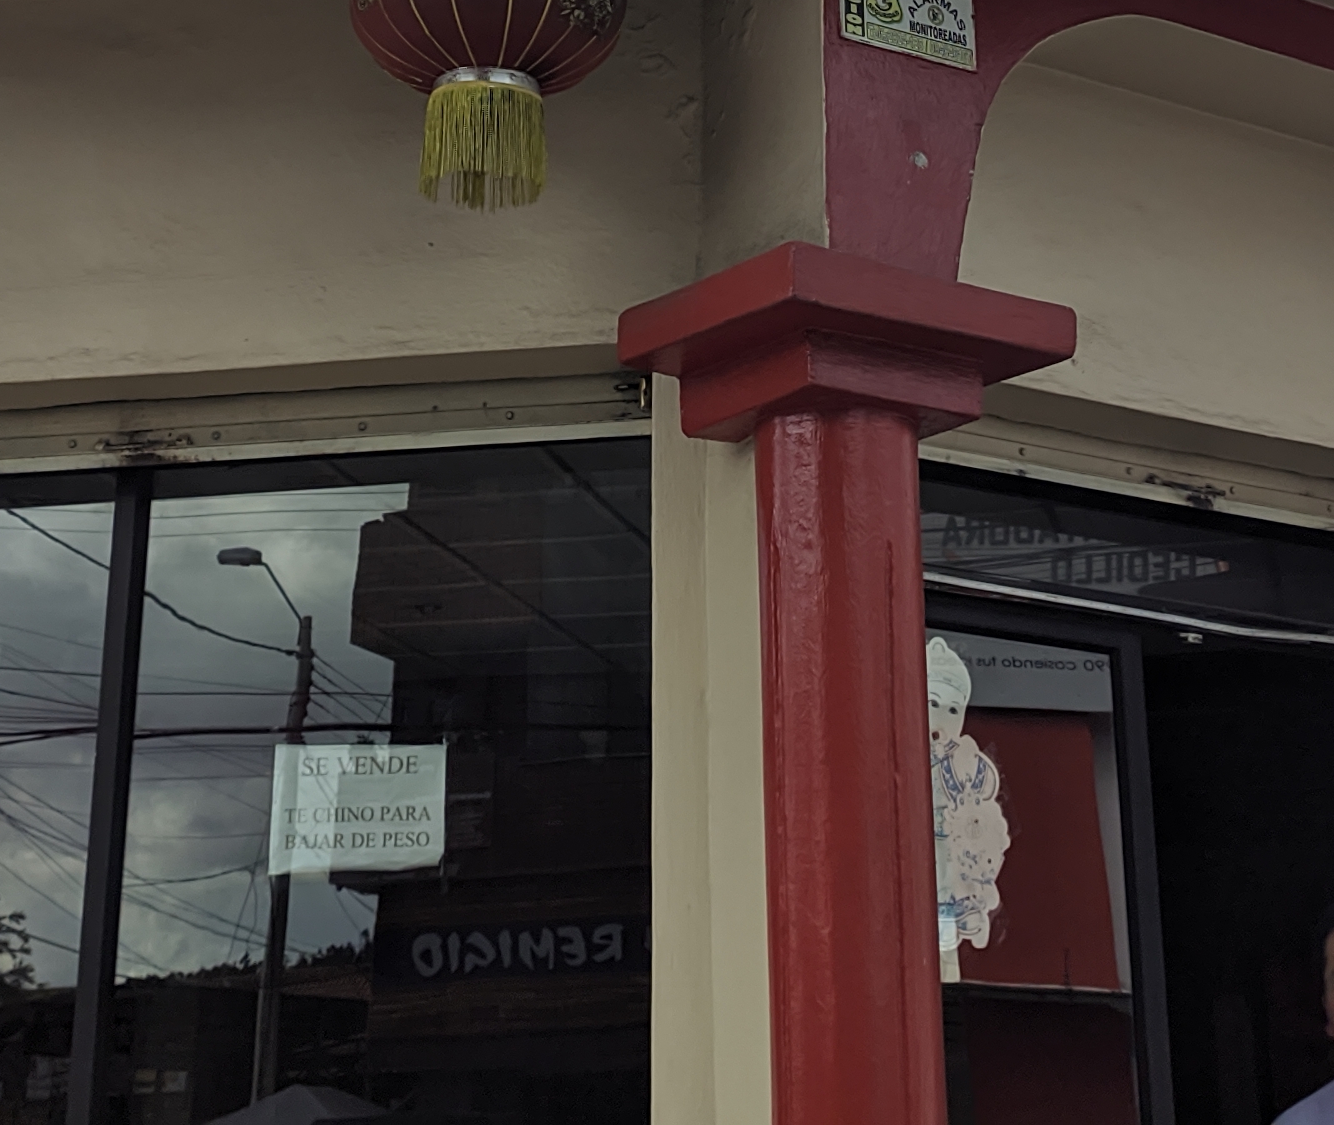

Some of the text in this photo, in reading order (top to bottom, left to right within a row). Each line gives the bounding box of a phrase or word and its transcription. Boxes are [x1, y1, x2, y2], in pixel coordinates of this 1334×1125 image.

[909, 20, 968, 47] MONITOREADAS
[301, 754, 419, 776] SE VENDE
[284, 804, 431, 824] TE CHINO PARA
[284, 830, 430, 850] BAJAR DE PESO
